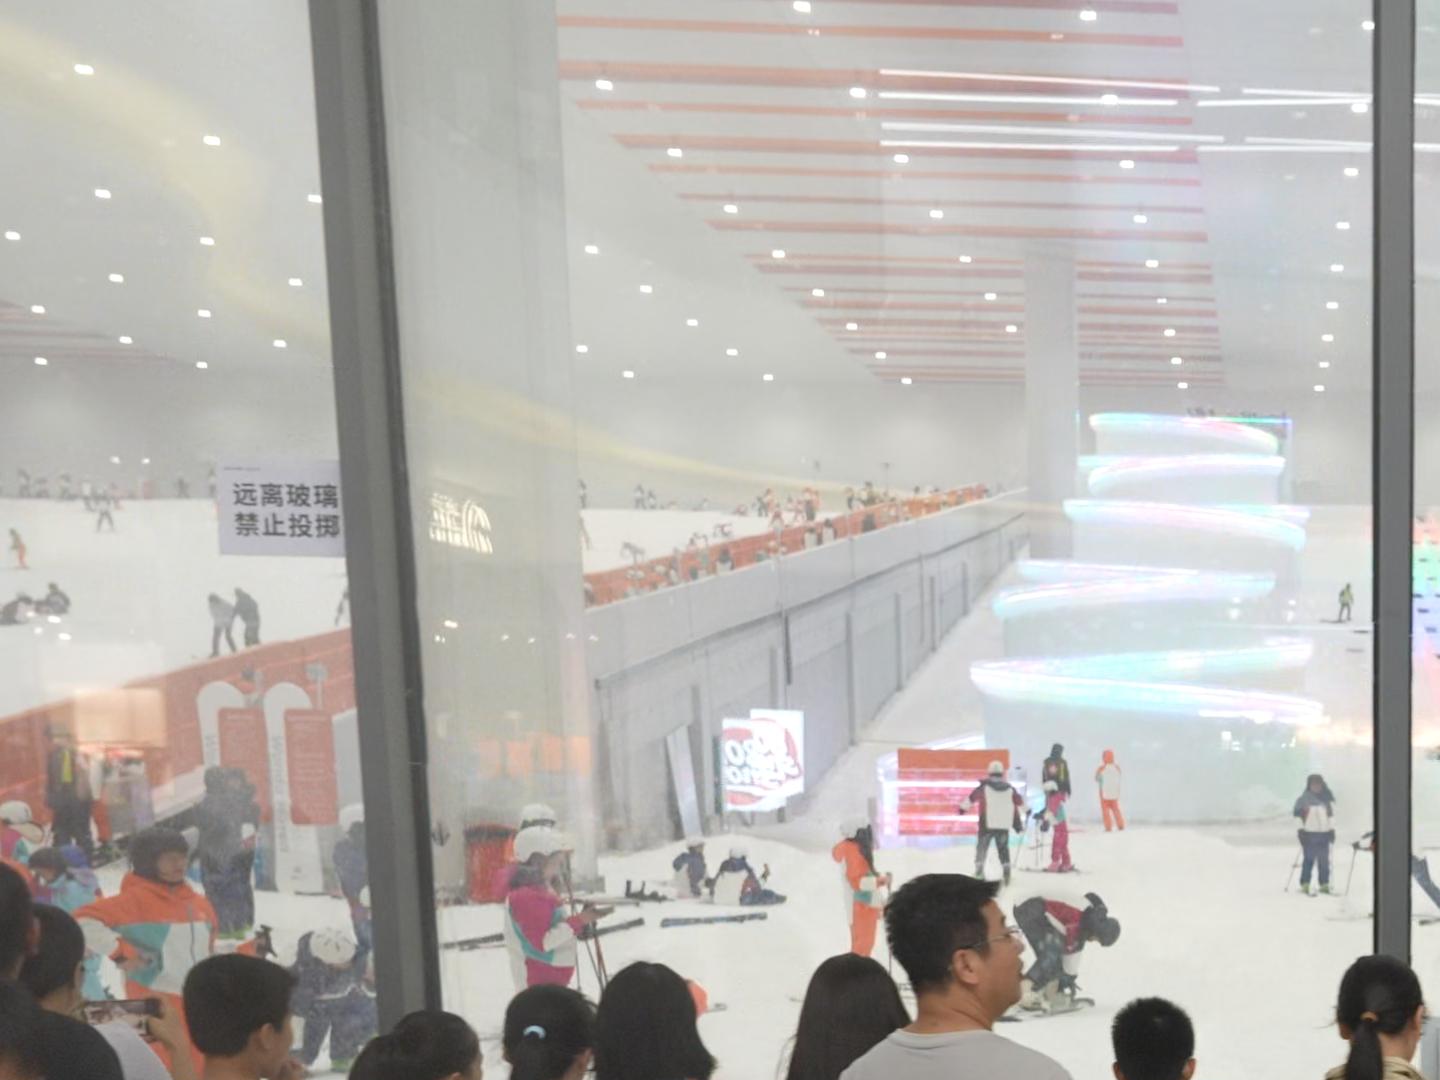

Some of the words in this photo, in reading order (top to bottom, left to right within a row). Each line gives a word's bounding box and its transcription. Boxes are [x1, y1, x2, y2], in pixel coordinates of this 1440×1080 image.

[232, 483, 339, 508] 远离玻璃
[233, 511, 341, 538] 禁止投掷
